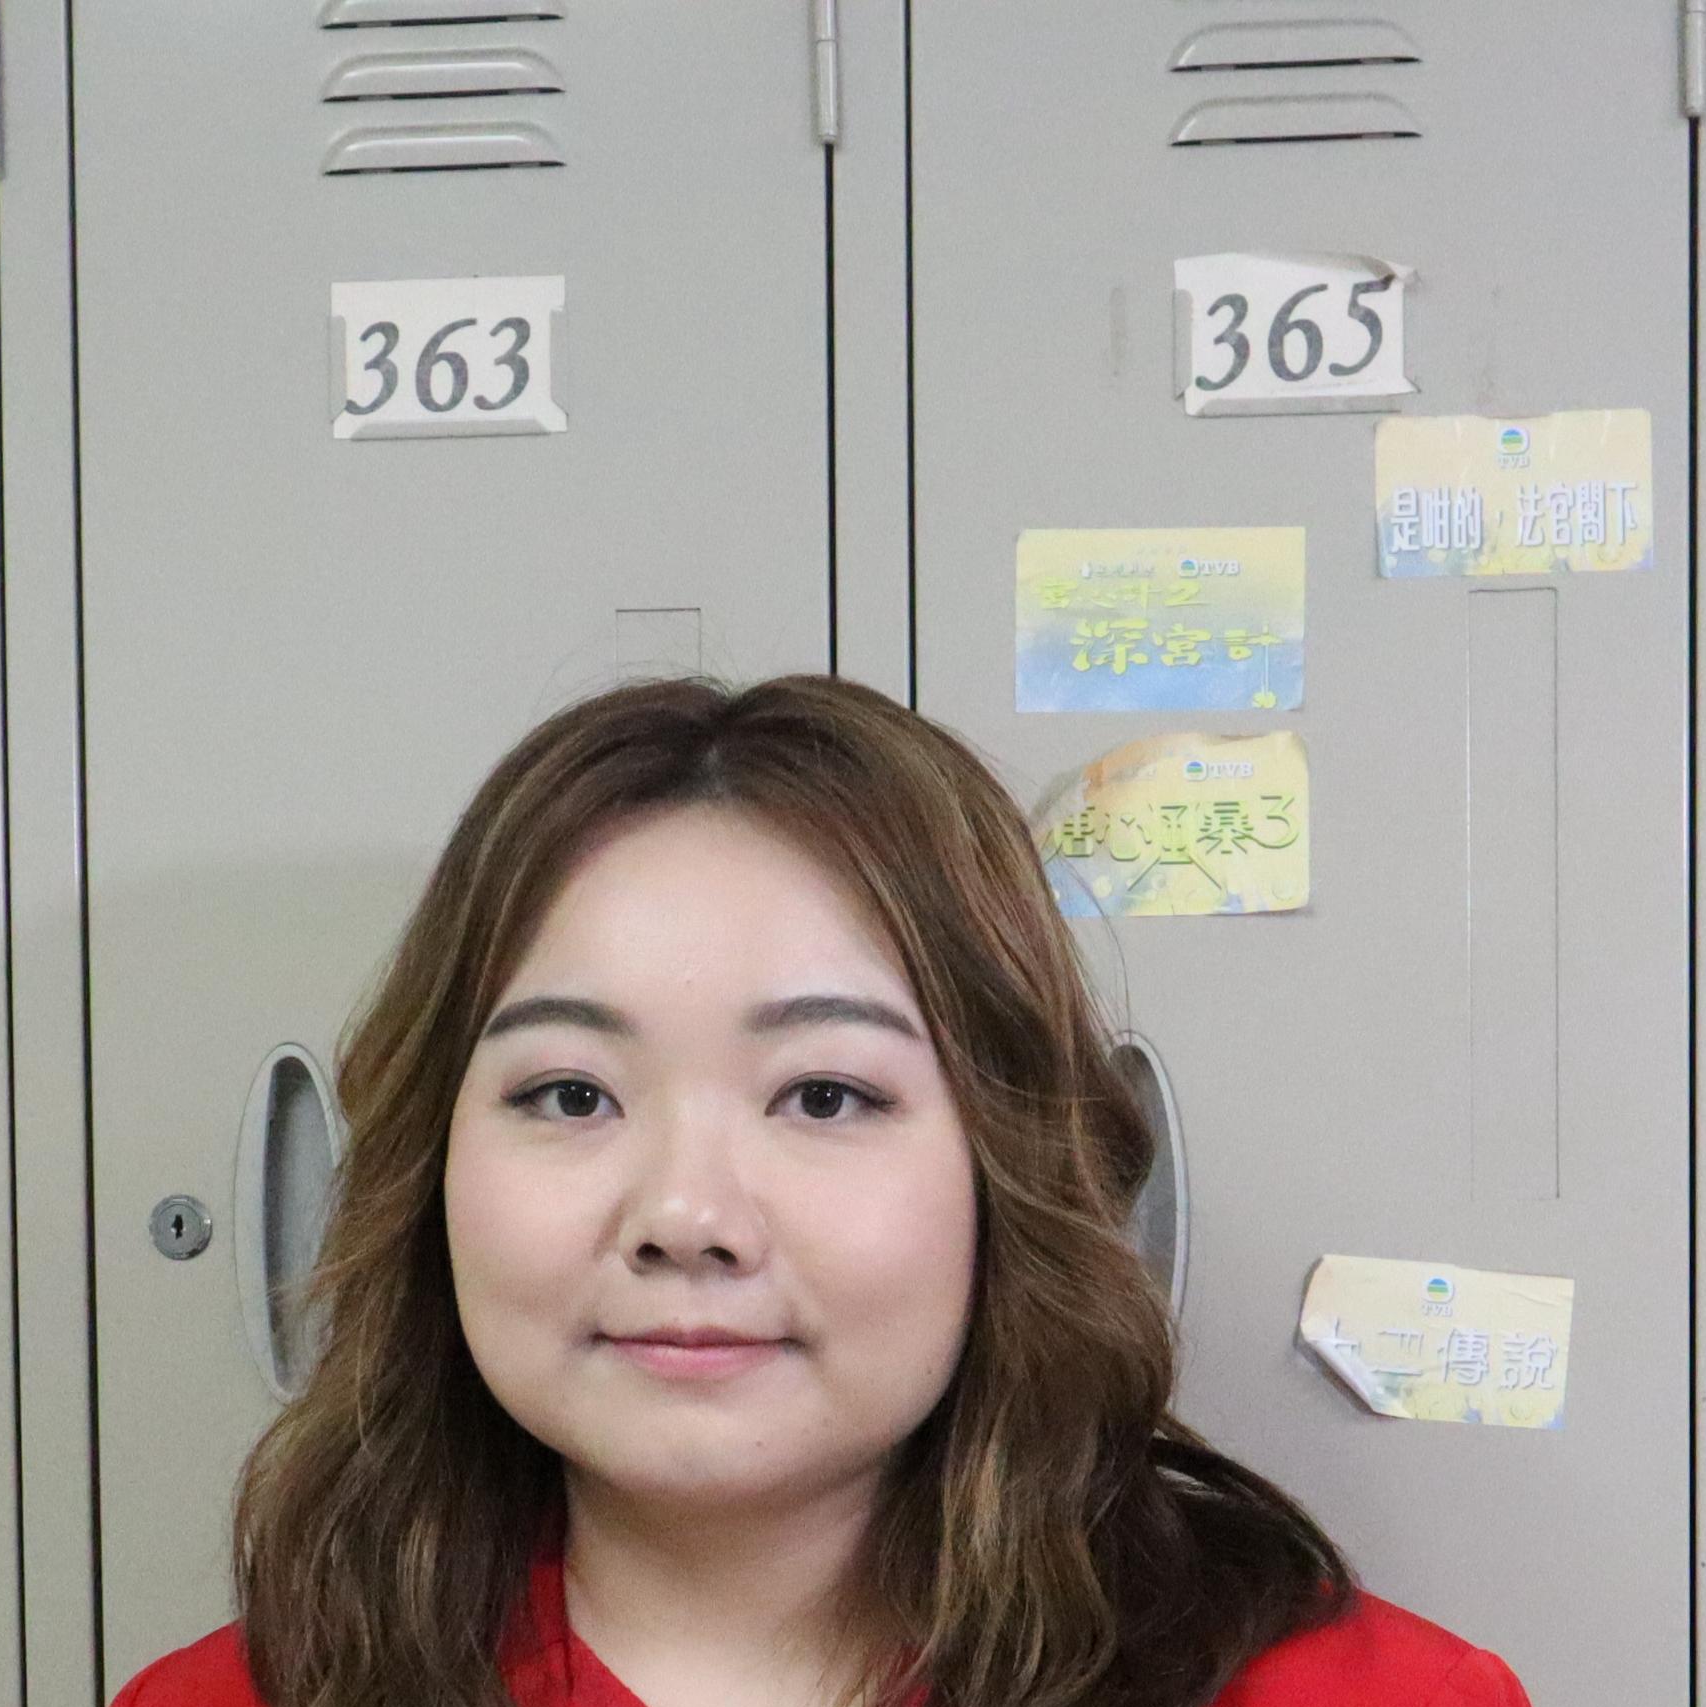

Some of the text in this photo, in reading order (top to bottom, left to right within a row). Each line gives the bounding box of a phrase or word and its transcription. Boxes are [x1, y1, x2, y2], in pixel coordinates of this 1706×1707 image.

[1195, 275, 1396, 392] 365
[344, 317, 531, 415] 363
[1199, 560, 1241, 576] TVB
[1422, 1304, 1453, 1317] TVB
